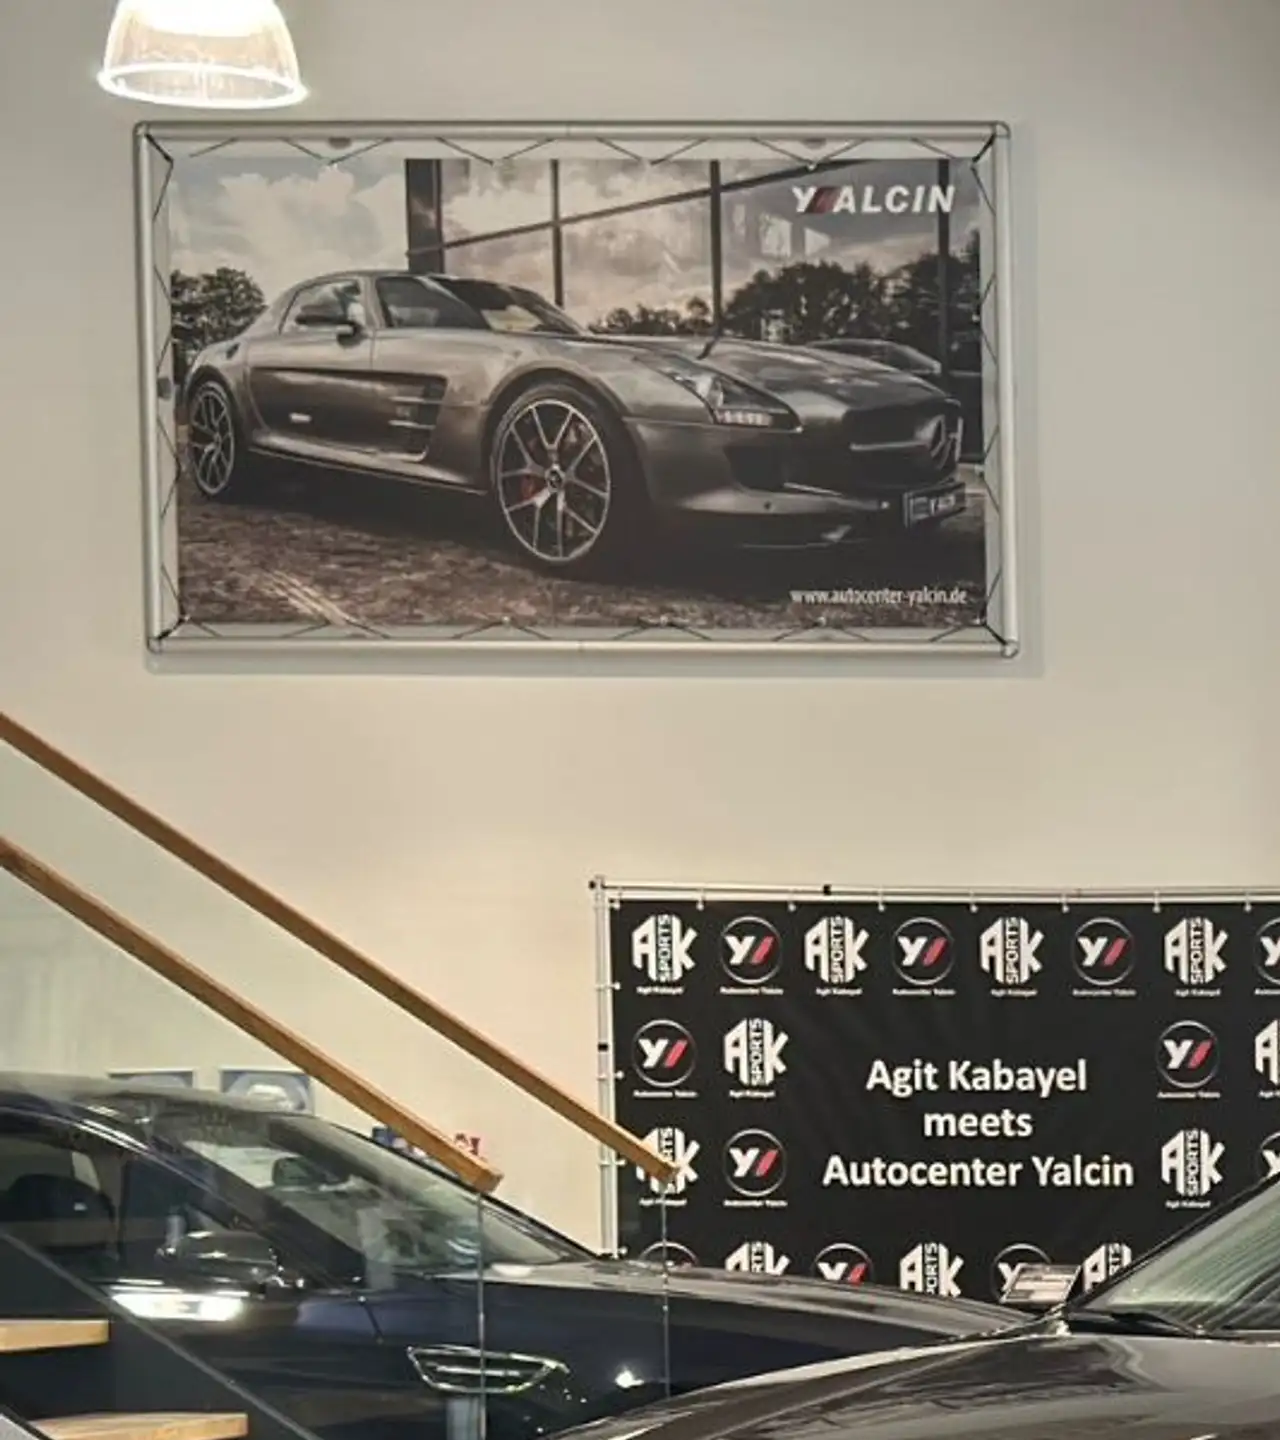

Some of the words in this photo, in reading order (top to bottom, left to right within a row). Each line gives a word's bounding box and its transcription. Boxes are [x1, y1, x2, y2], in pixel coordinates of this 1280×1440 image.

[865, 1058, 939, 1098] Agit
[948, 1058, 1088, 1099] Kabayel
[923, 1108, 1034, 1137] meets
[821, 1154, 1024, 1188] Autocenter
[1031, 1154, 1135, 1187] Yalcin
